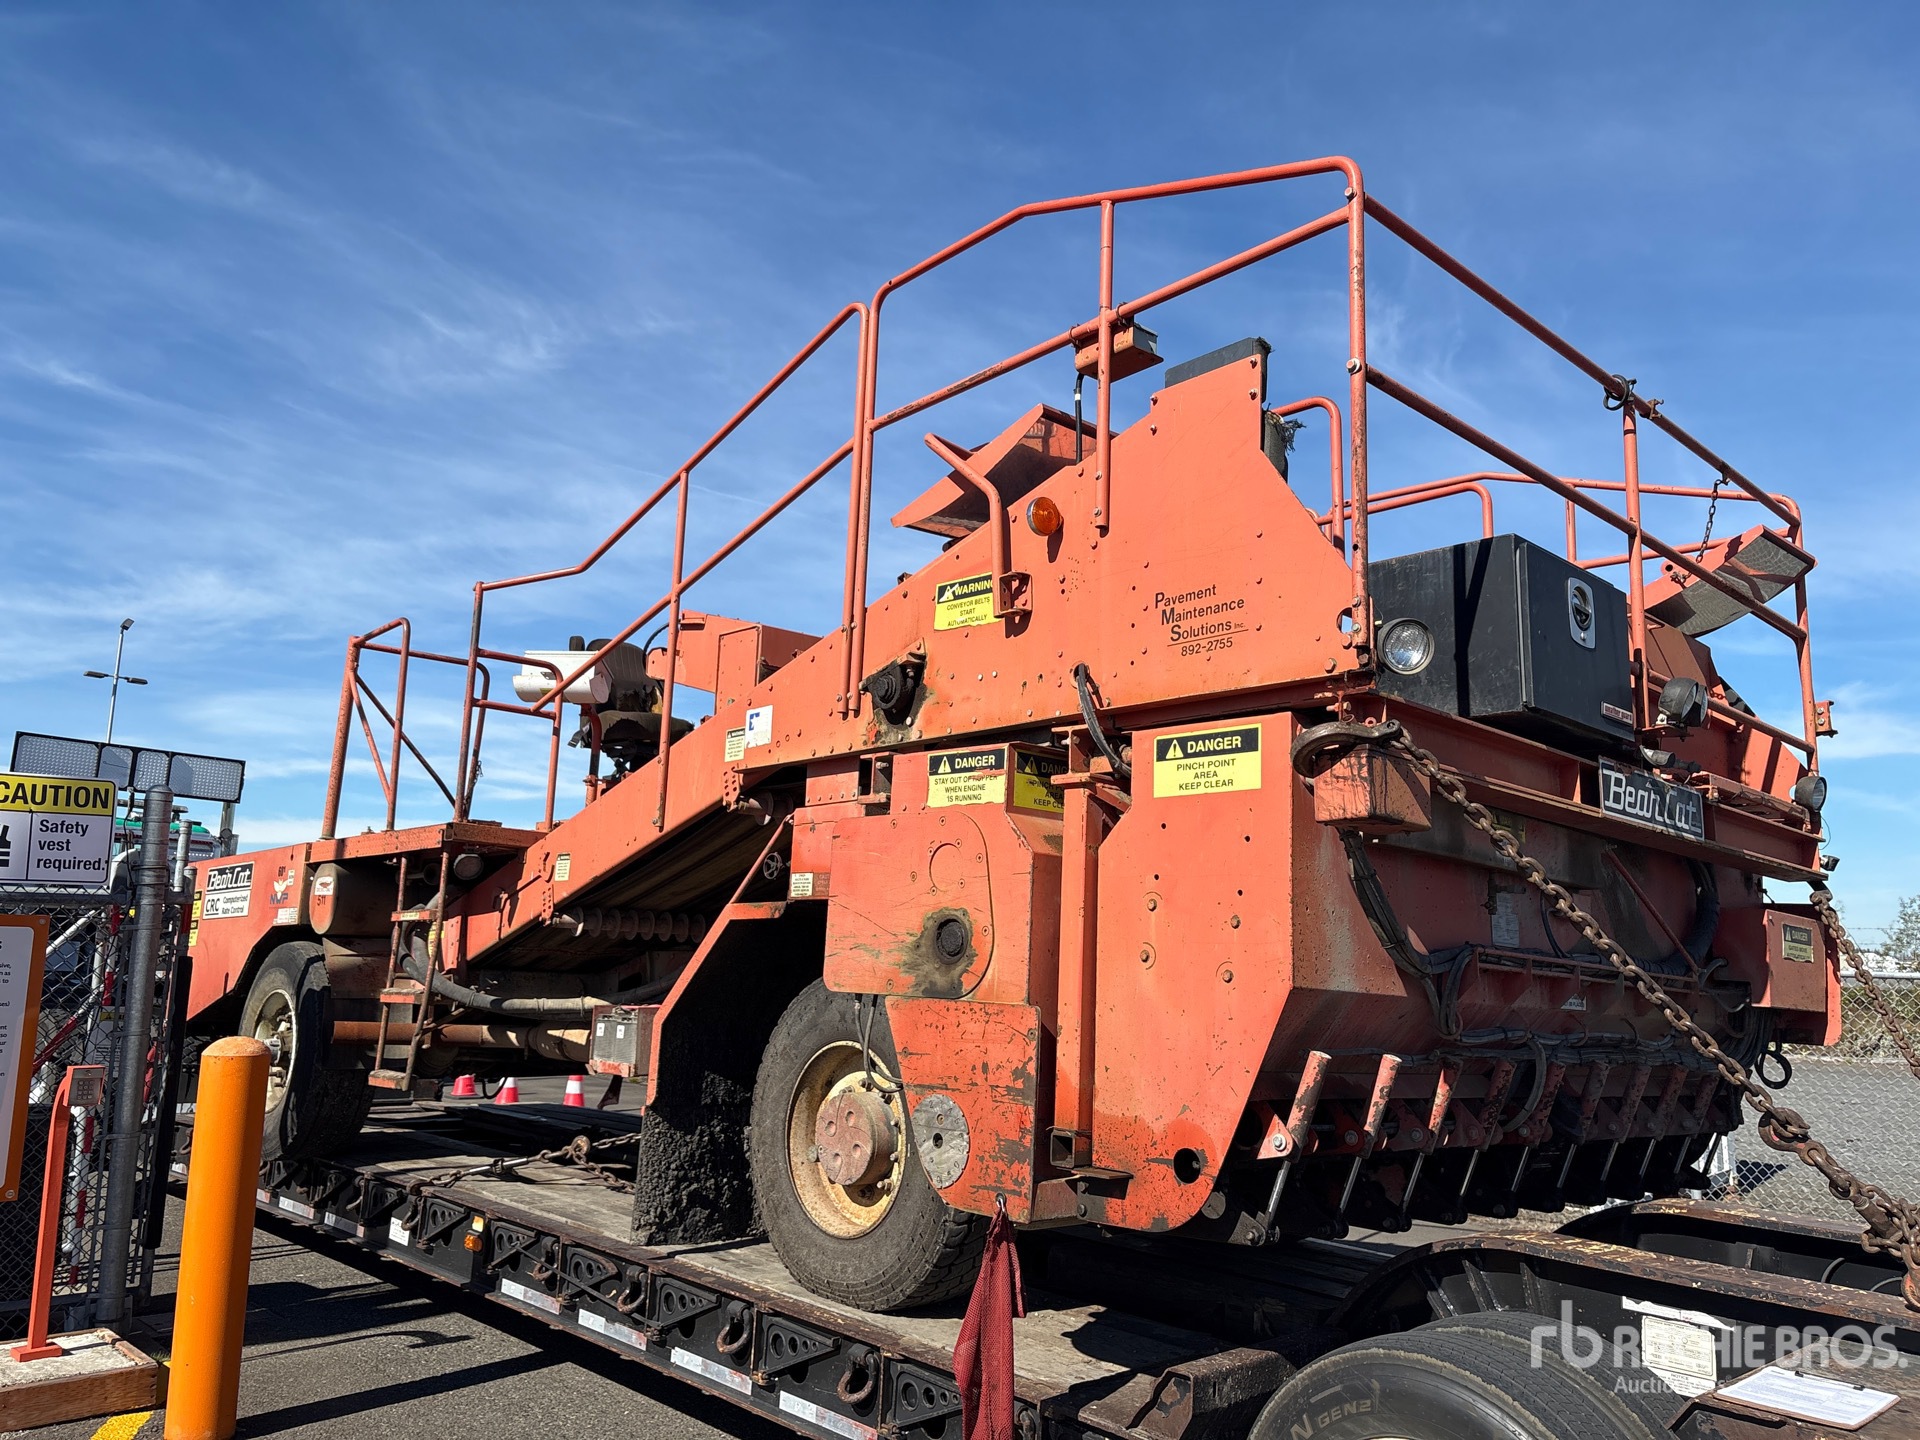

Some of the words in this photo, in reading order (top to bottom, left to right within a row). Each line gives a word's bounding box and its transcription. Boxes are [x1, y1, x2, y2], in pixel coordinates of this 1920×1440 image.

[954, 579, 993, 596] WARNIN
[946, 600, 974, 611] CONVEYOR
[974, 596, 990, 606] BELTS
[1155, 584, 1216, 609] Pavement
[960, 608, 976, 617] START
[1161, 599, 1245, 625] Maintenance
[947, 614, 988, 627] AUTOMATICALLY
[1170, 621, 1232, 641] Solutions
[1181, 637, 1233, 656] 892-2755
[1187, 736, 1242, 754] DANGER
[955, 755, 996, 769] DANGER
[1041, 762, 1068, 775] DANG
[1177, 763, 1205, 771] PINCH
[1207, 758, 1236, 769] POINT
[934, 777, 949, 786] STAY
[950, 776, 962, 784] OUT
[1193, 770, 1218, 780] AREA
[945, 785, 963, 794] WHEN
[963, 783, 986, 792] ENGINE
[1179, 782, 1202, 791] KEEP
[1204, 779, 1234, 789] CLEAR
[0, 781, 109, 809] CAUTION
[955, 793, 982, 802] RUNNING
[1033, 797, 1051, 806] KEEP
[1052, 800, 1065, 809] CLE
[39, 819, 89, 837] Safety
[38, 838, 71, 852] vest
[36, 857, 105, 872] required.
[206, 897, 220, 913] CRC
